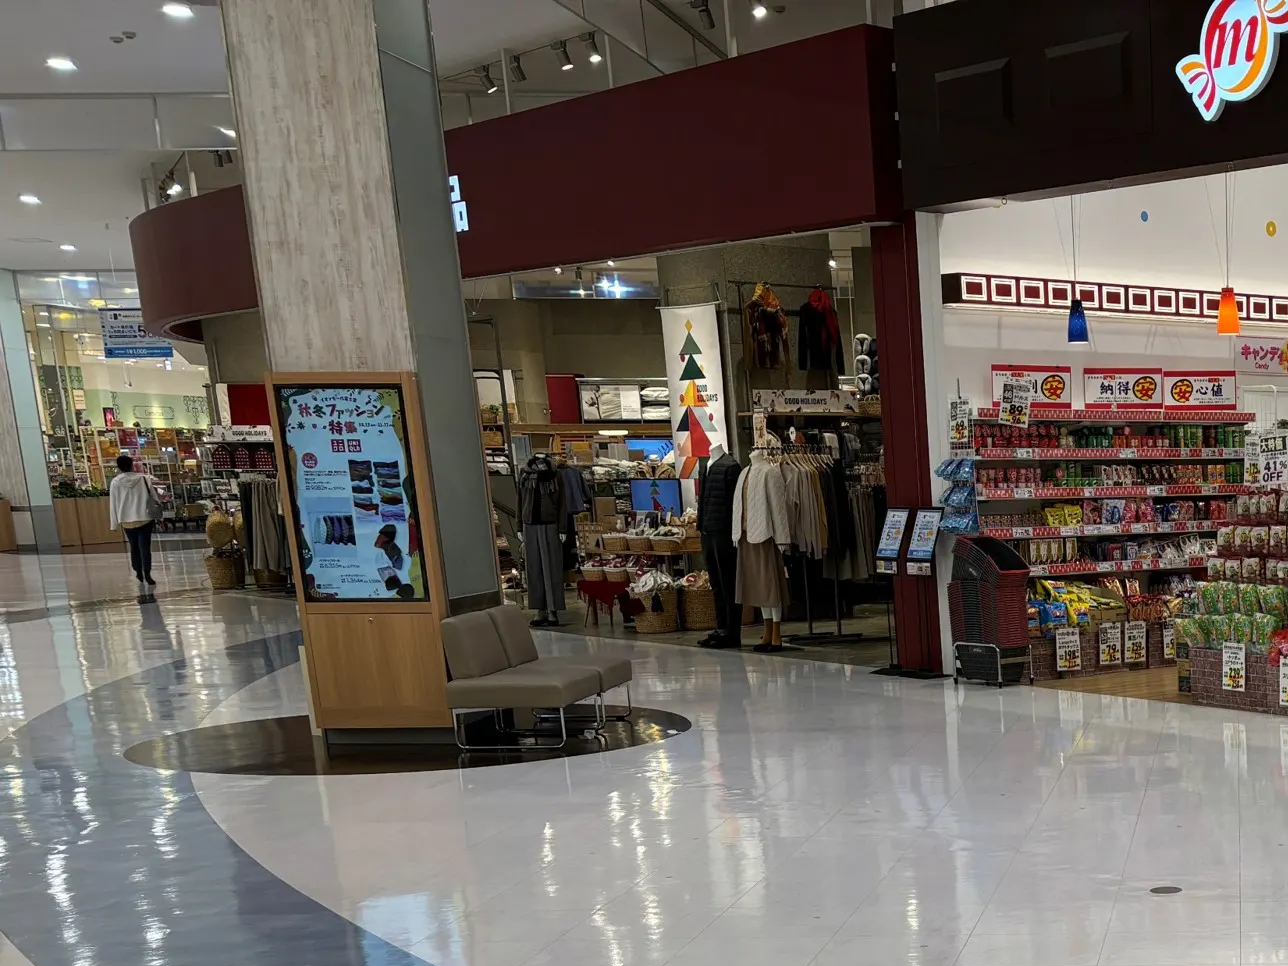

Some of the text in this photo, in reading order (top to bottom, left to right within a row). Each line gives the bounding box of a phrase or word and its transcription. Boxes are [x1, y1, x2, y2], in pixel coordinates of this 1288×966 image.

[1255, 362, 1269, 370] Candy
[784, 397, 828, 405] GOOD HOLIDAYS
[298, 403, 385, 419] 秋冬ファッション
[328, 420, 358, 436] 特集
[1263, 460, 1287, 472] 41%
[1262, 472, 1283, 482] OFF
